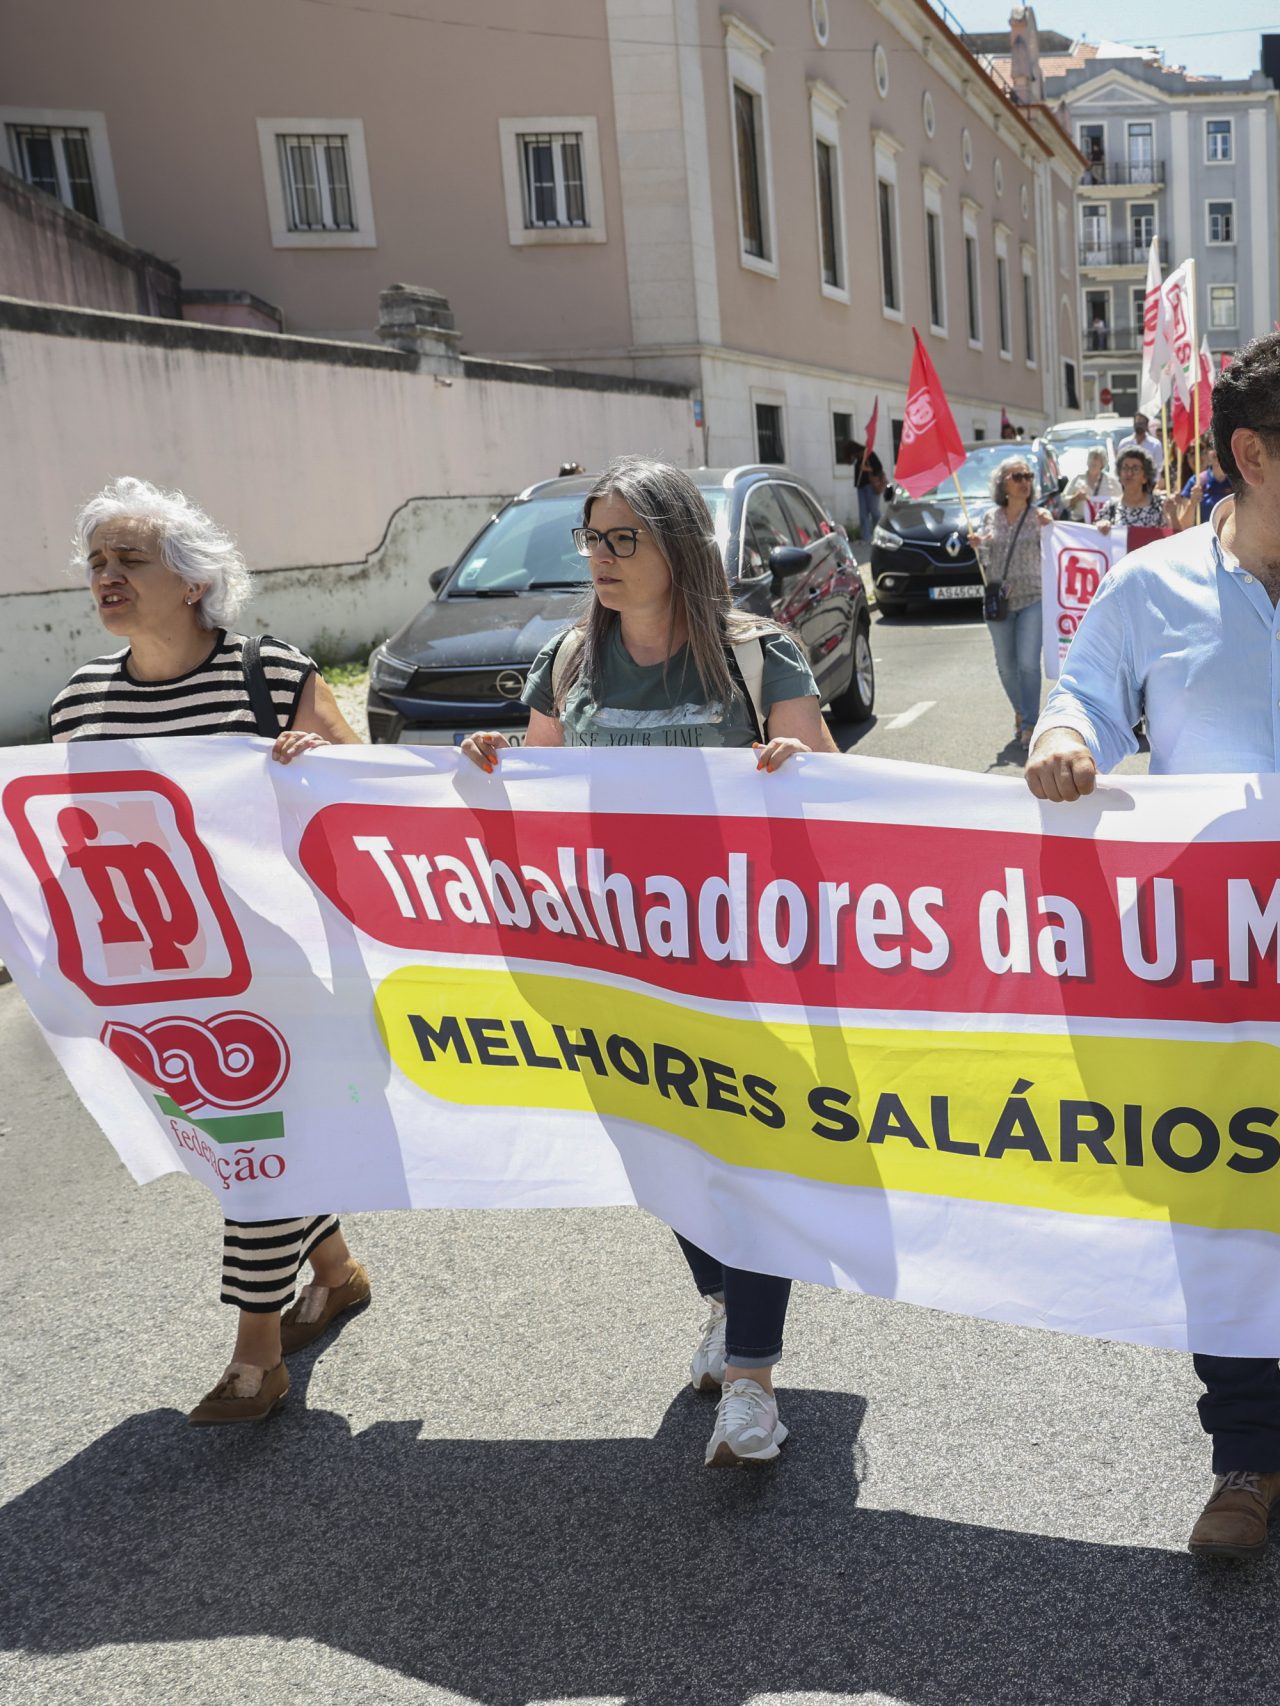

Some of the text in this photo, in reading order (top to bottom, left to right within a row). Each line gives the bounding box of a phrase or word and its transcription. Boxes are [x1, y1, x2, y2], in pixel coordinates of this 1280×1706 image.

[661, 727, 706, 747] TIME
[353, 835, 950, 970] Trabalhadores
[978, 867, 1088, 978] da
[406, 1014, 787, 1129] MELHORES
[170, 1119, 286, 1190] federação
